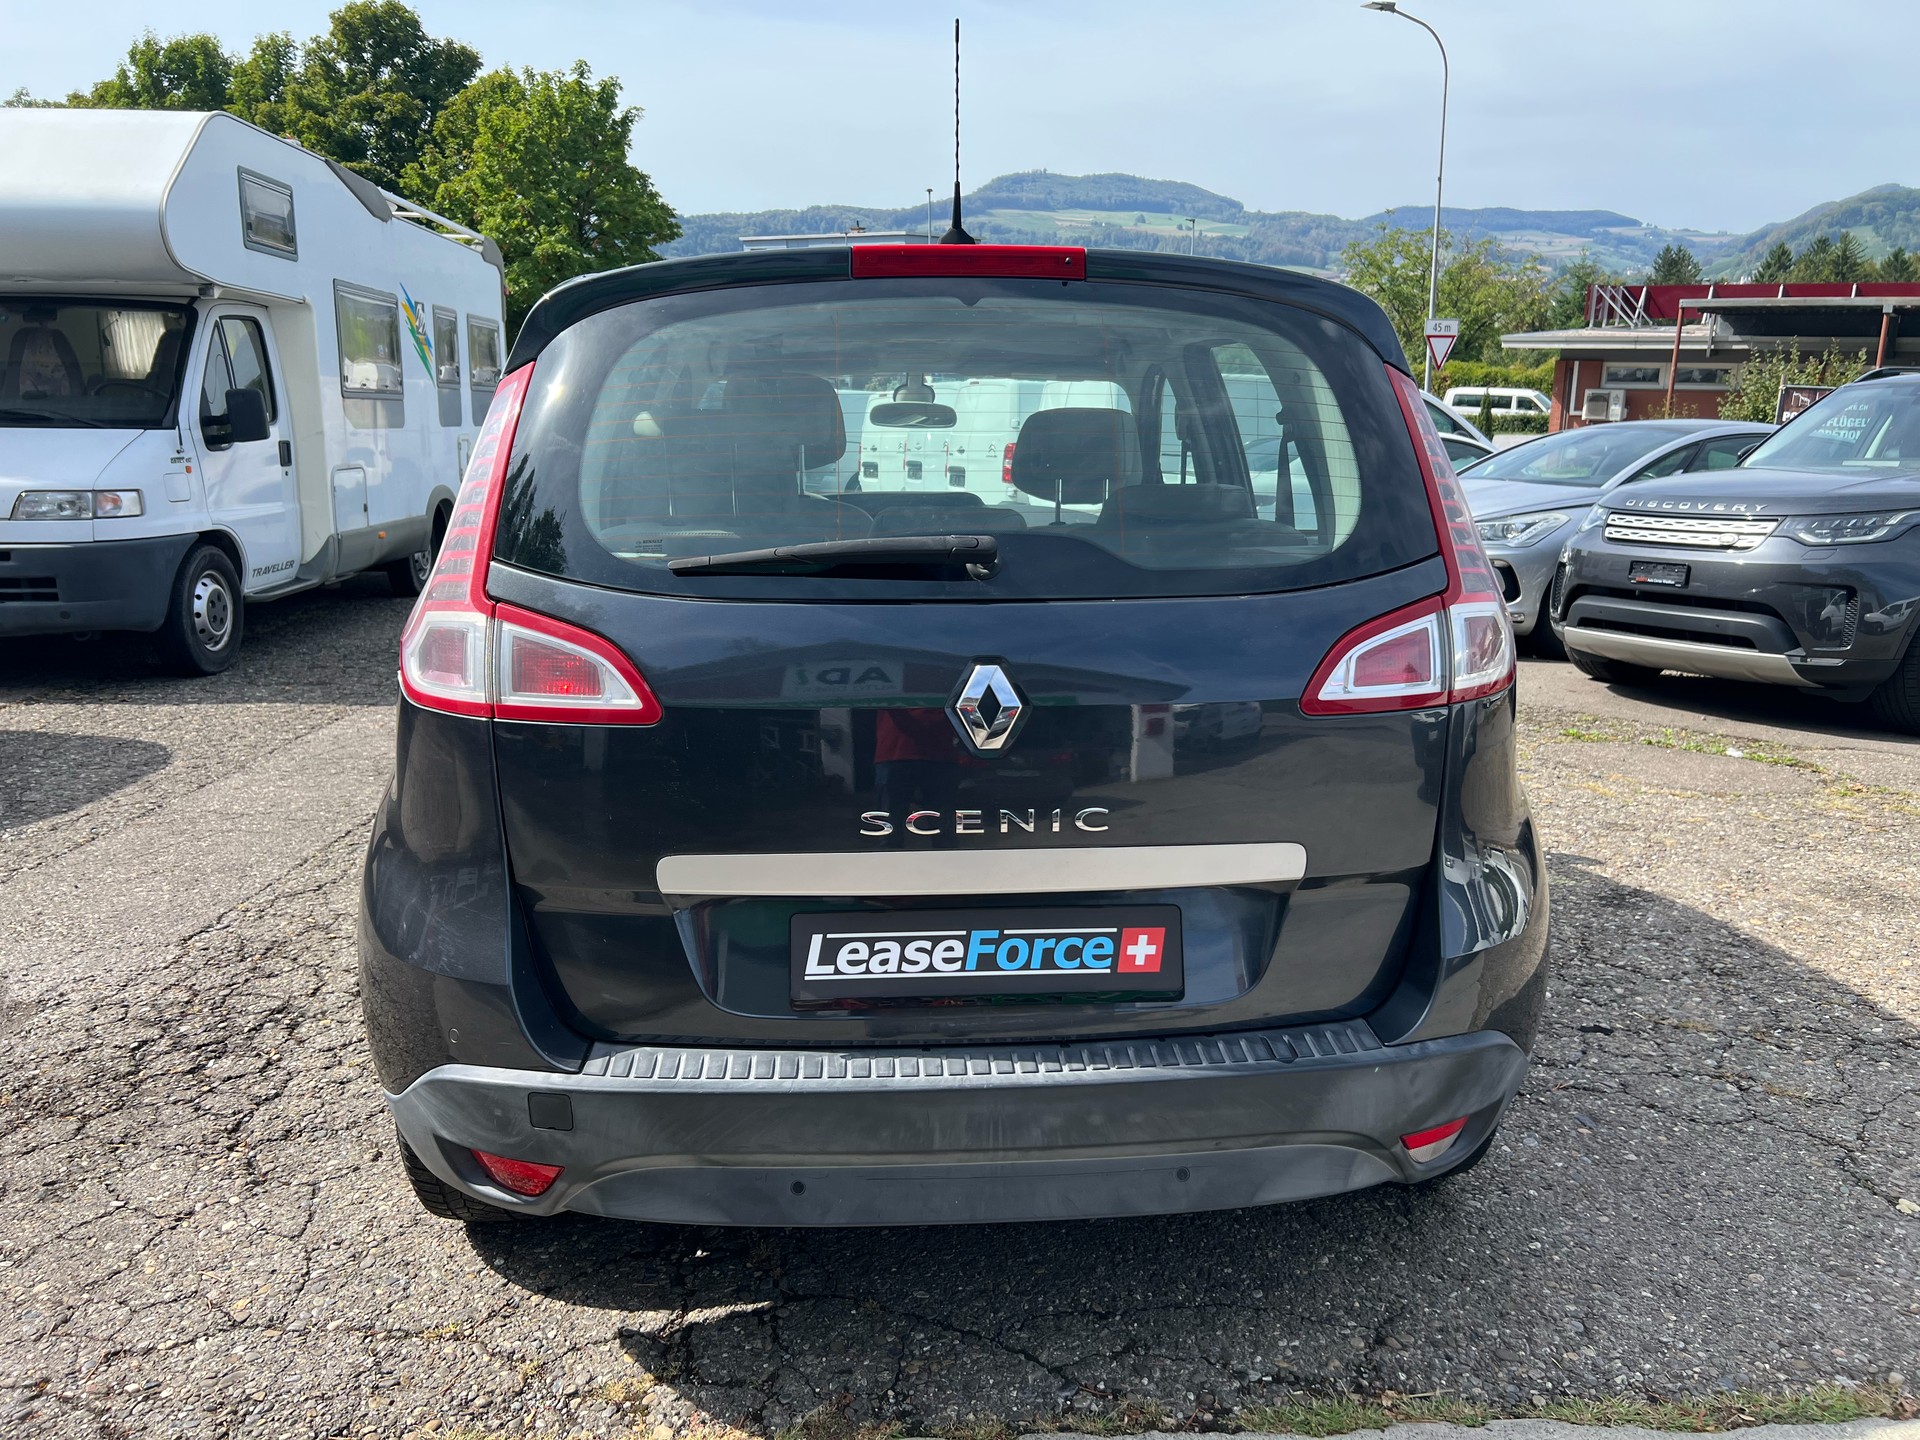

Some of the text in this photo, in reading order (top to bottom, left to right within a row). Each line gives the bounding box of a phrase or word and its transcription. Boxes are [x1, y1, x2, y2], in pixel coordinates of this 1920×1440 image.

[1433, 323, 1442, 332] 45
[1625, 499, 1768, 512] DISCOVERY
[252, 560, 295, 578] TRAVELLER
[859, 807, 1109, 836] SCENIC
[804, 929, 1114, 975] LeaseForce
